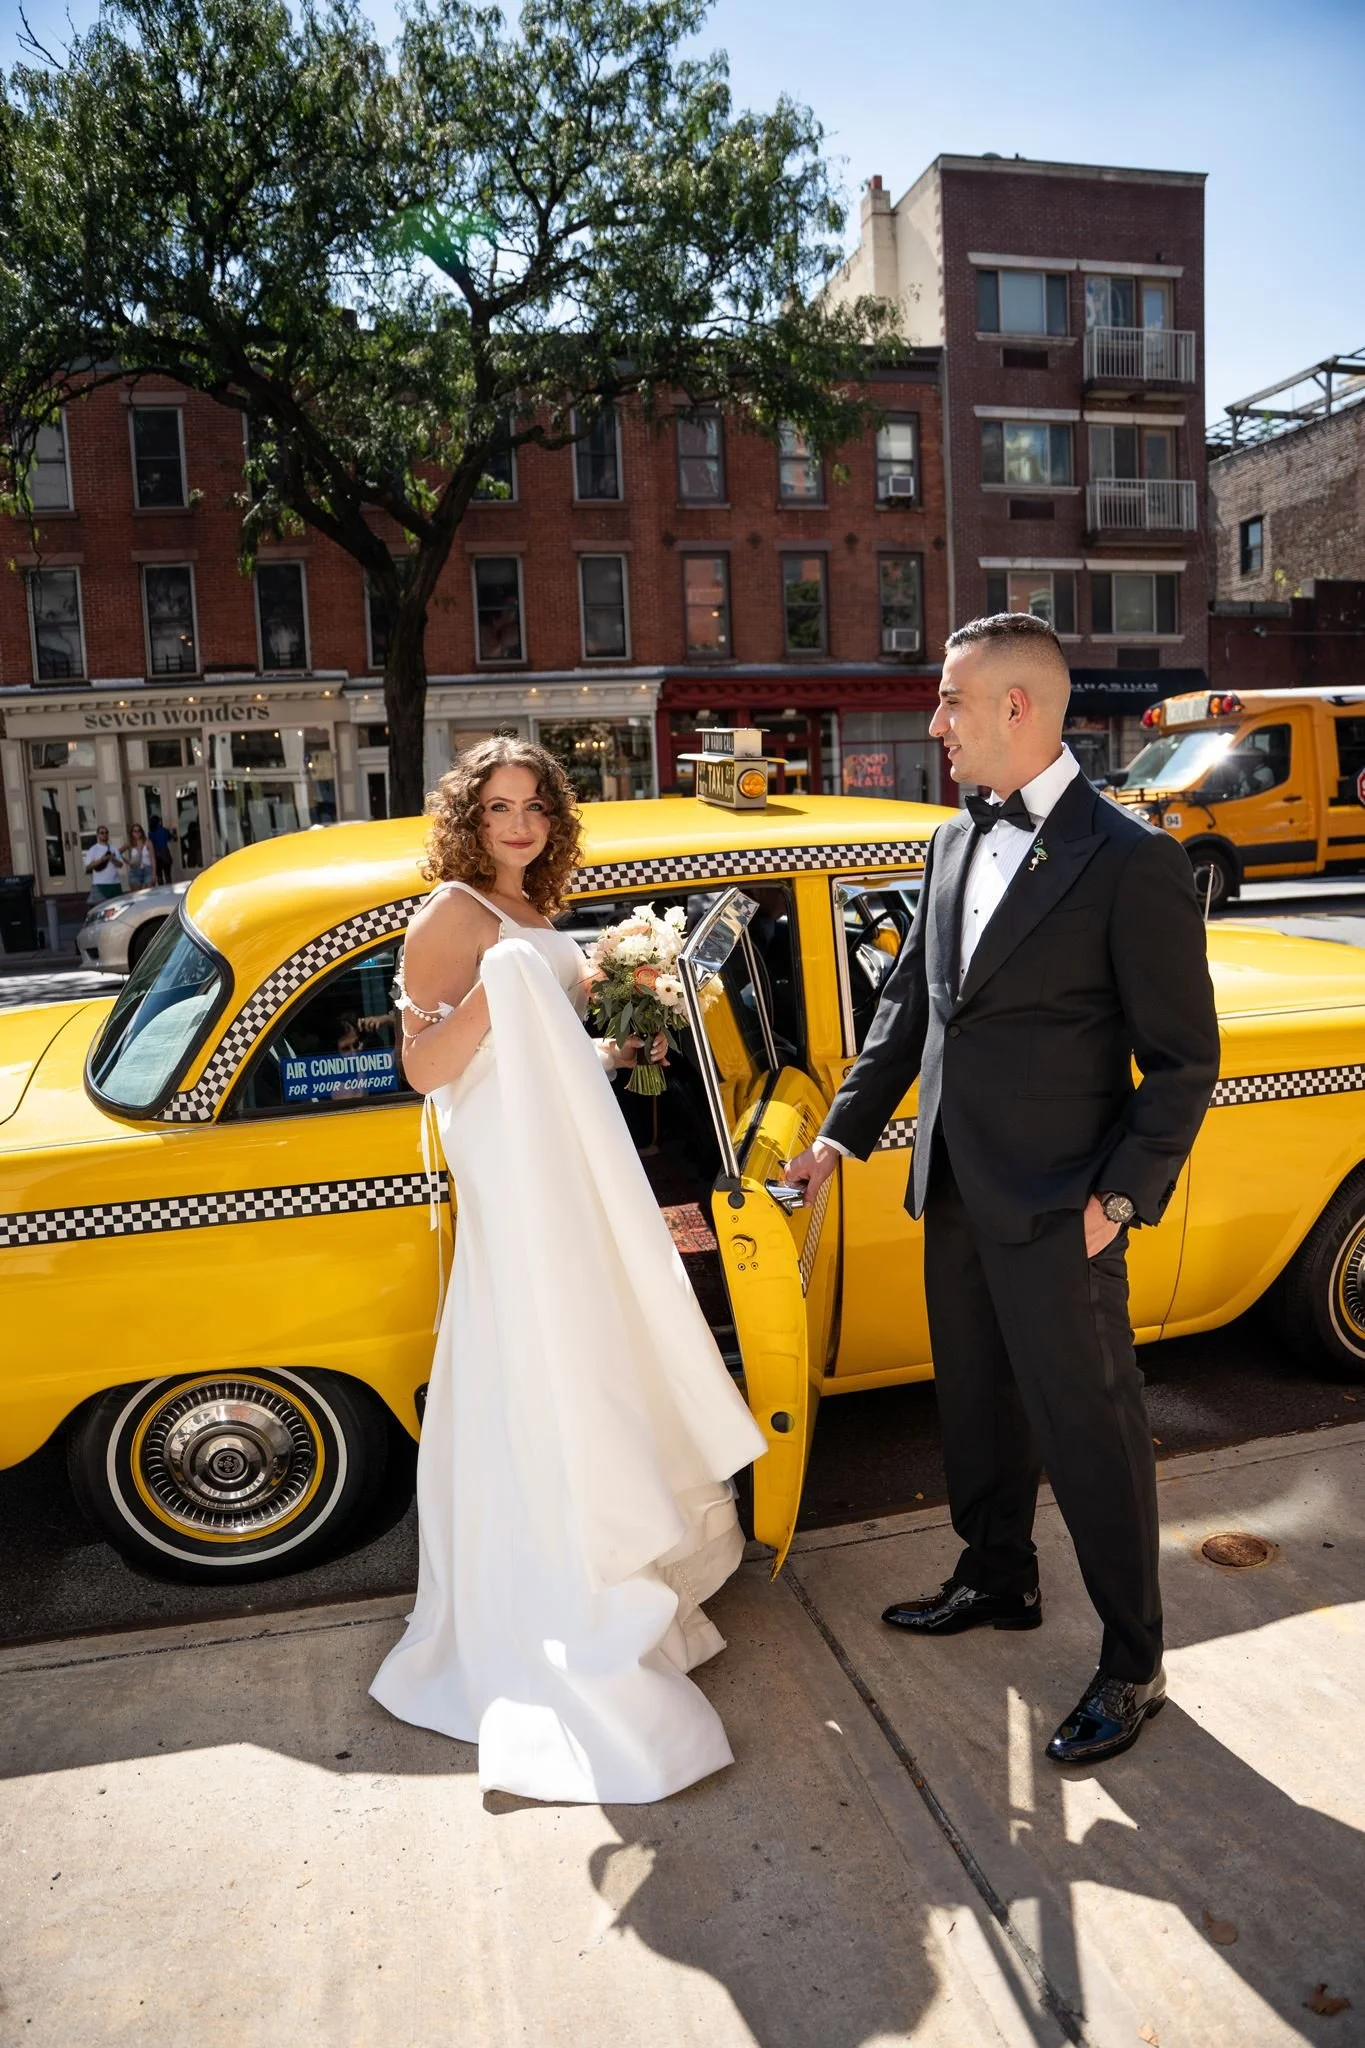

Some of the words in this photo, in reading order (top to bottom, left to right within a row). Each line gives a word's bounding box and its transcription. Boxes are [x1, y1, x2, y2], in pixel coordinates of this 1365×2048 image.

[84, 711, 156, 729] seven
[162, 702, 270, 724] wonders
[707, 764, 724, 795] TAXI
[1166, 815, 1179, 826] 94
[286, 1062, 307, 1079] AIR
[310, 1053, 393, 1077] CONDITIONED
[288, 1084, 308, 1096] FOR
[312, 1081, 341, 1094] YOUR
[344, 1075, 395, 1090] COMFORT
